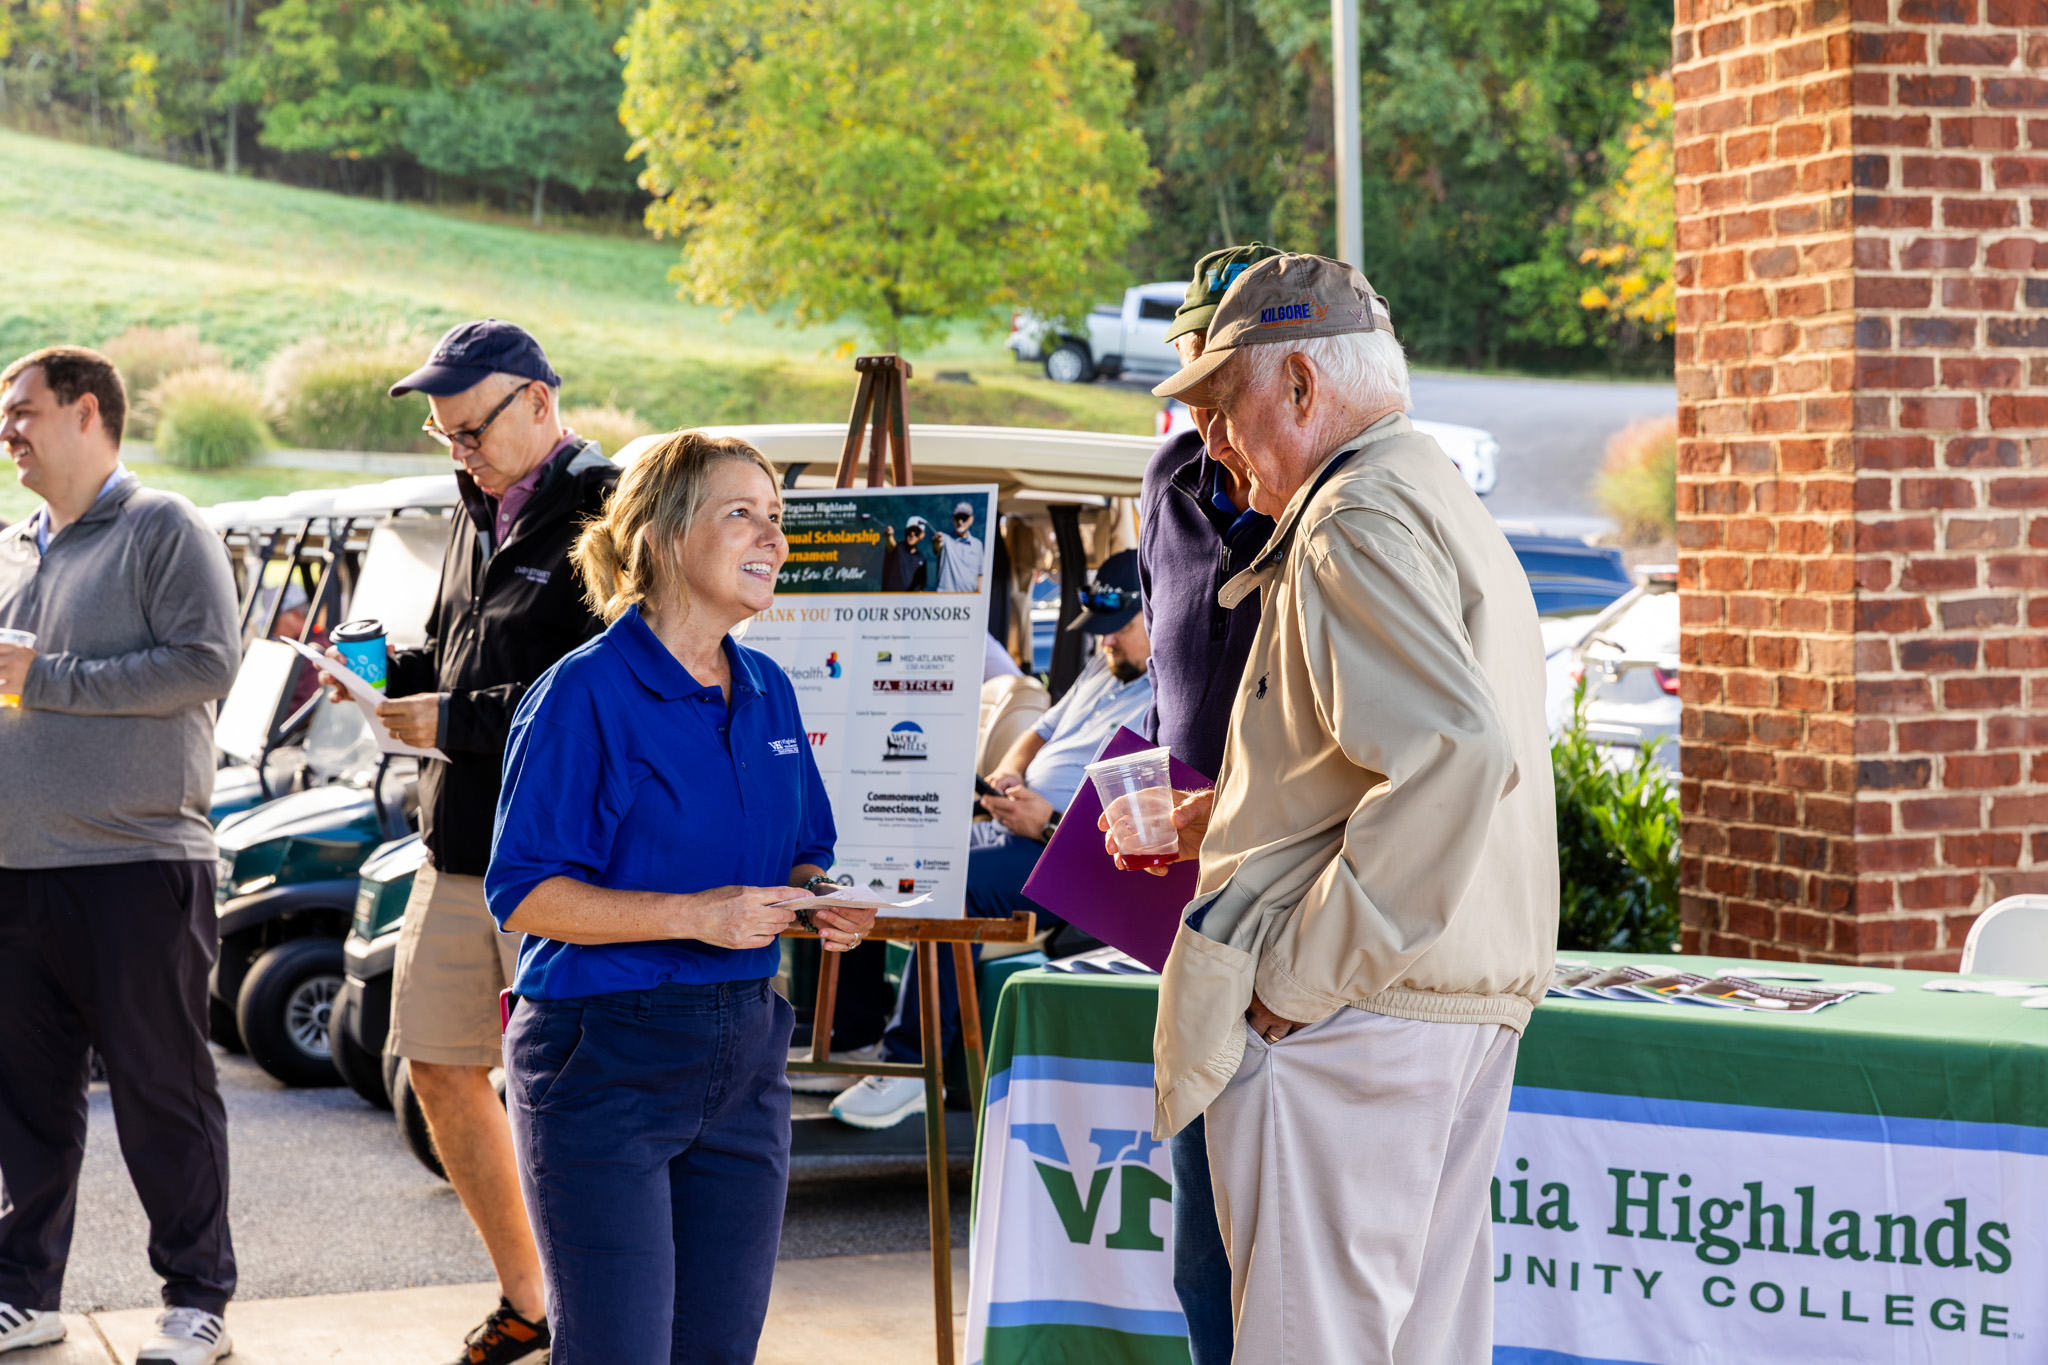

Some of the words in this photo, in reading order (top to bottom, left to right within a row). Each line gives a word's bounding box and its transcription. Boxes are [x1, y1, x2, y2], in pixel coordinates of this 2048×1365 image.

[1261, 303, 1311, 323] KILGORE
[816, 502, 857, 513] Highlands
[785, 530, 813, 544] nnual
[814, 528, 880, 546] Scholarship
[785, 549, 838, 562] urnament
[751, 607, 796, 622] HANK
[799, 607, 831, 622] YOU
[834, 607, 853, 622] TO
[857, 606, 889, 622] OUR
[892, 606, 971, 622] SPONSORS
[898, 680, 954, 691] STREET
[867, 791, 939, 802] Commonwealth
[863, 803, 922, 815] Connections,
[924, 805, 941, 815] Inc.
[1606, 1166, 2012, 1275] Highlands
[1493, 1252, 1663, 1300] UNITY
[1702, 1275, 2010, 1338] COLLEGE
